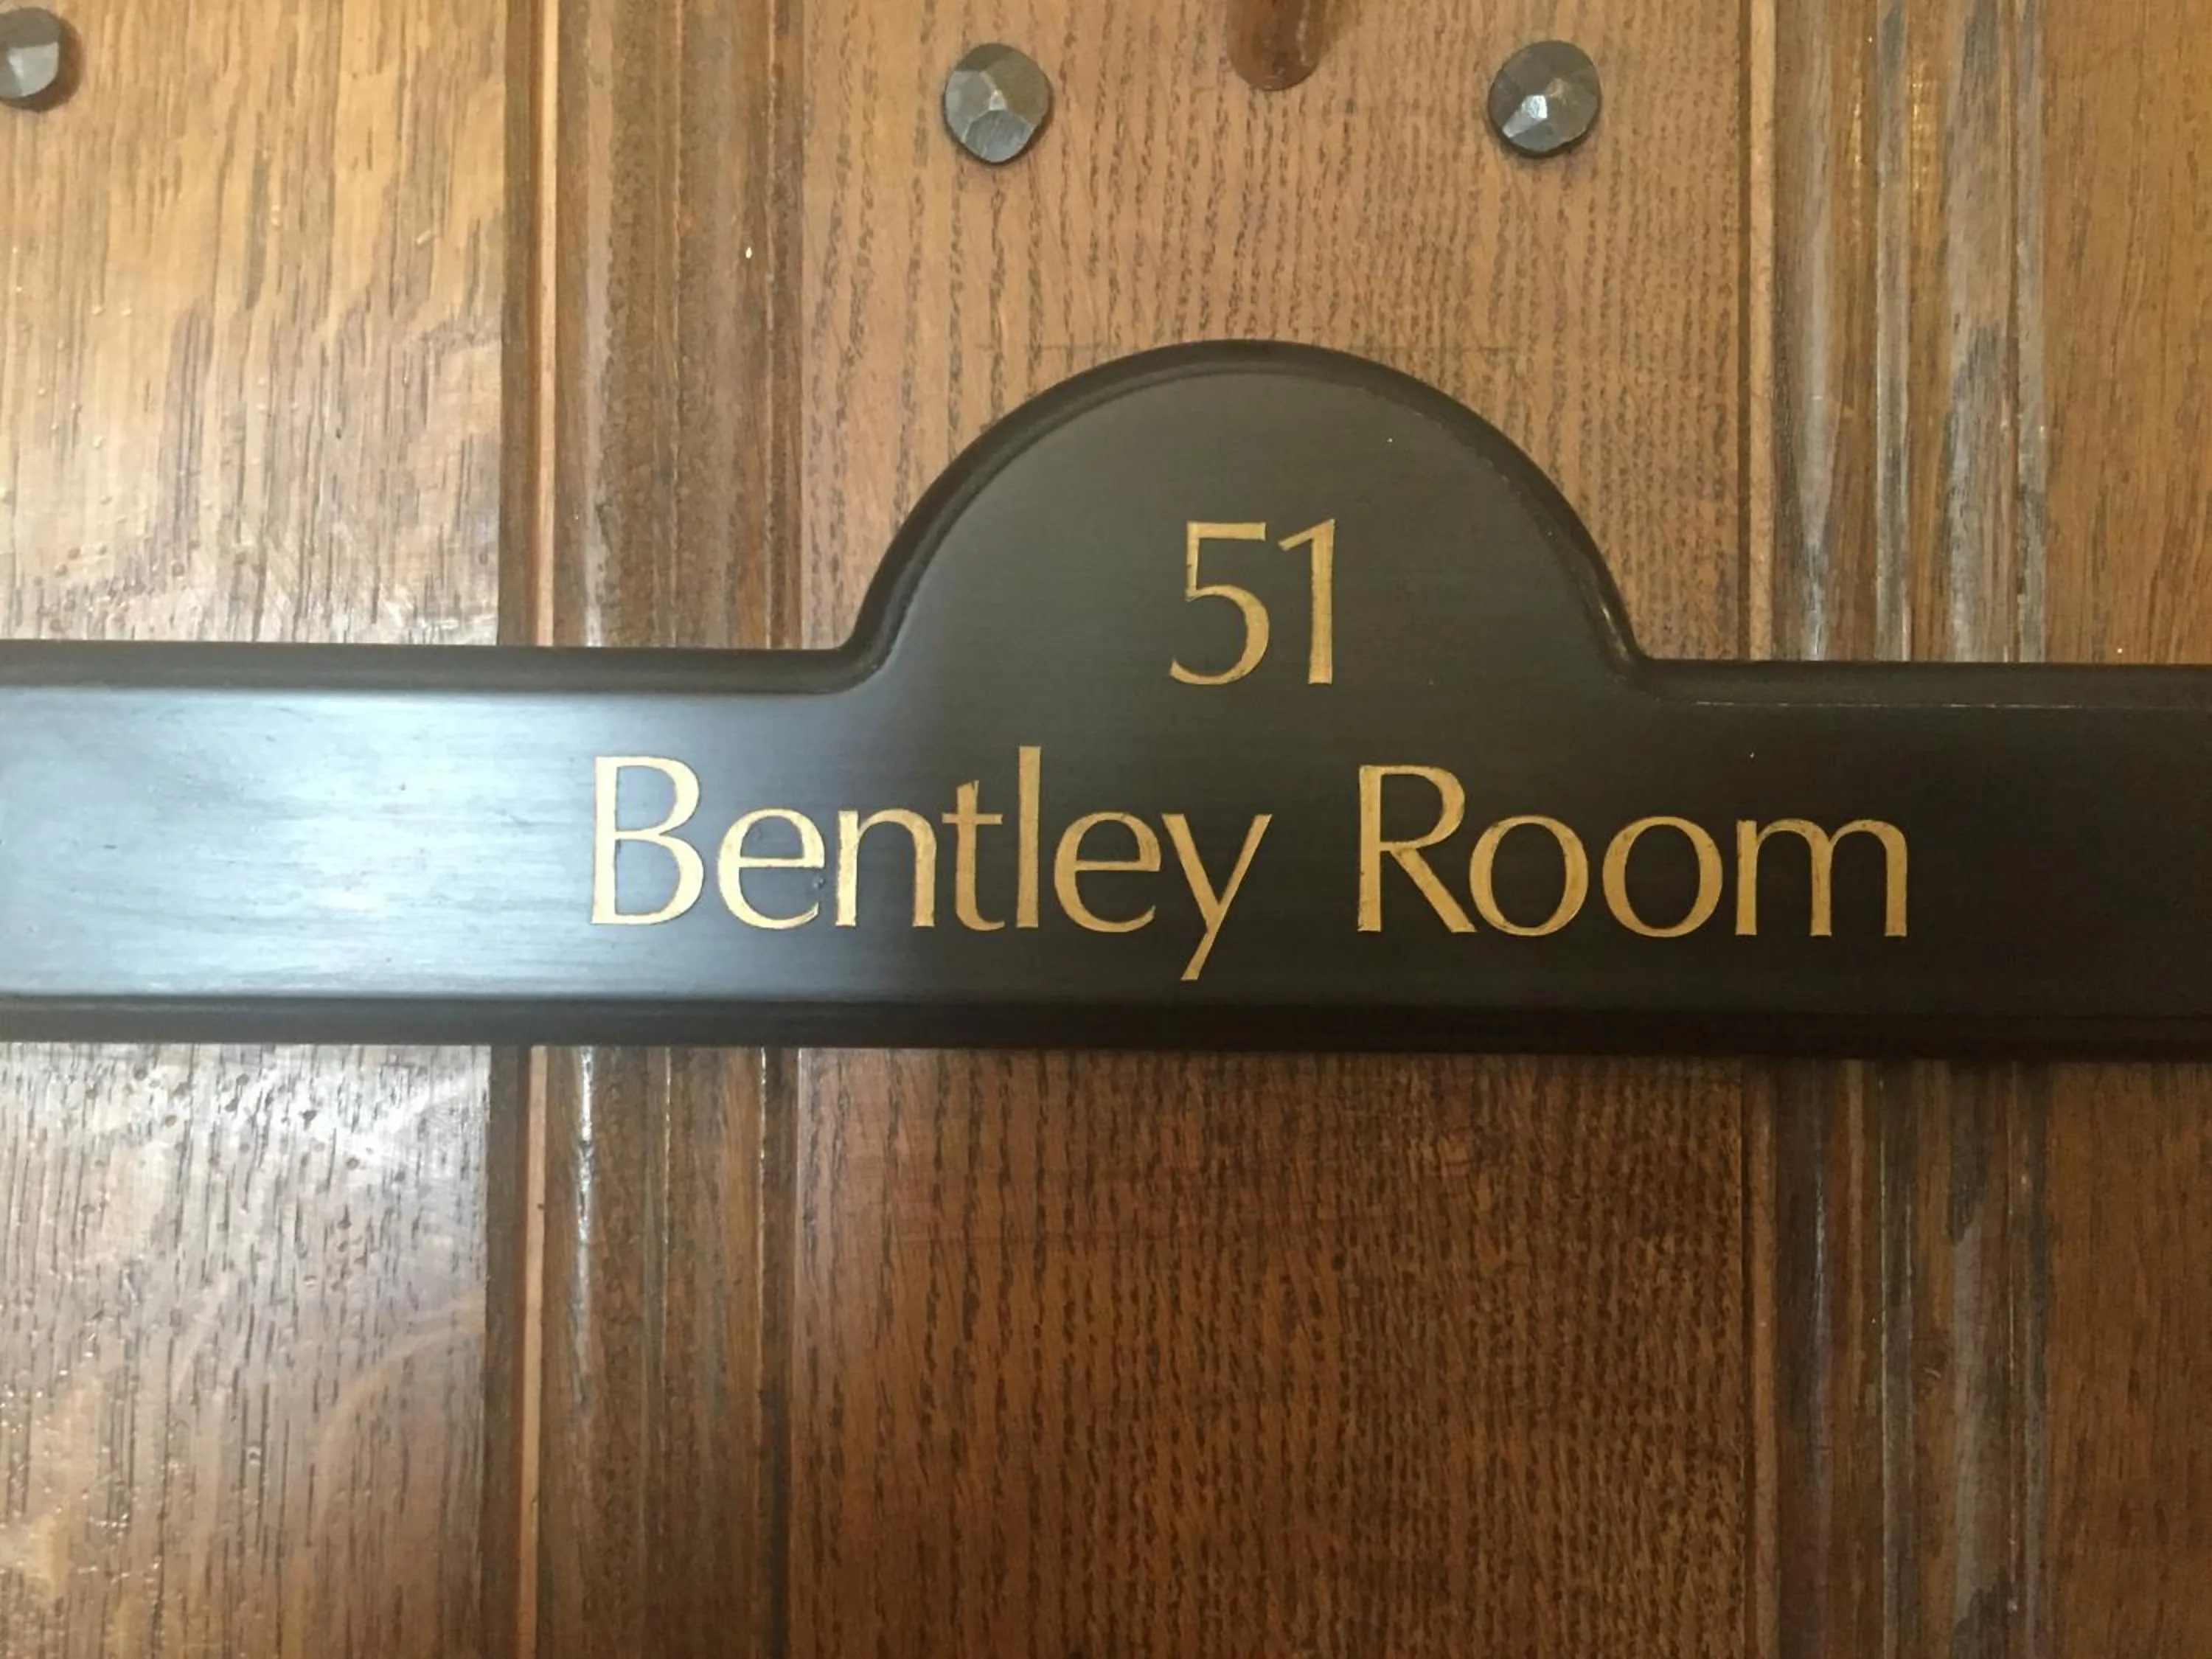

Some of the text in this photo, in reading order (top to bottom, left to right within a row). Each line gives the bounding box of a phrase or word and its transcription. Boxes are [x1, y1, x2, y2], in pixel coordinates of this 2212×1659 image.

[1169, 518, 1335, 687] 51
[589, 745, 1908, 981] Bentley Room
